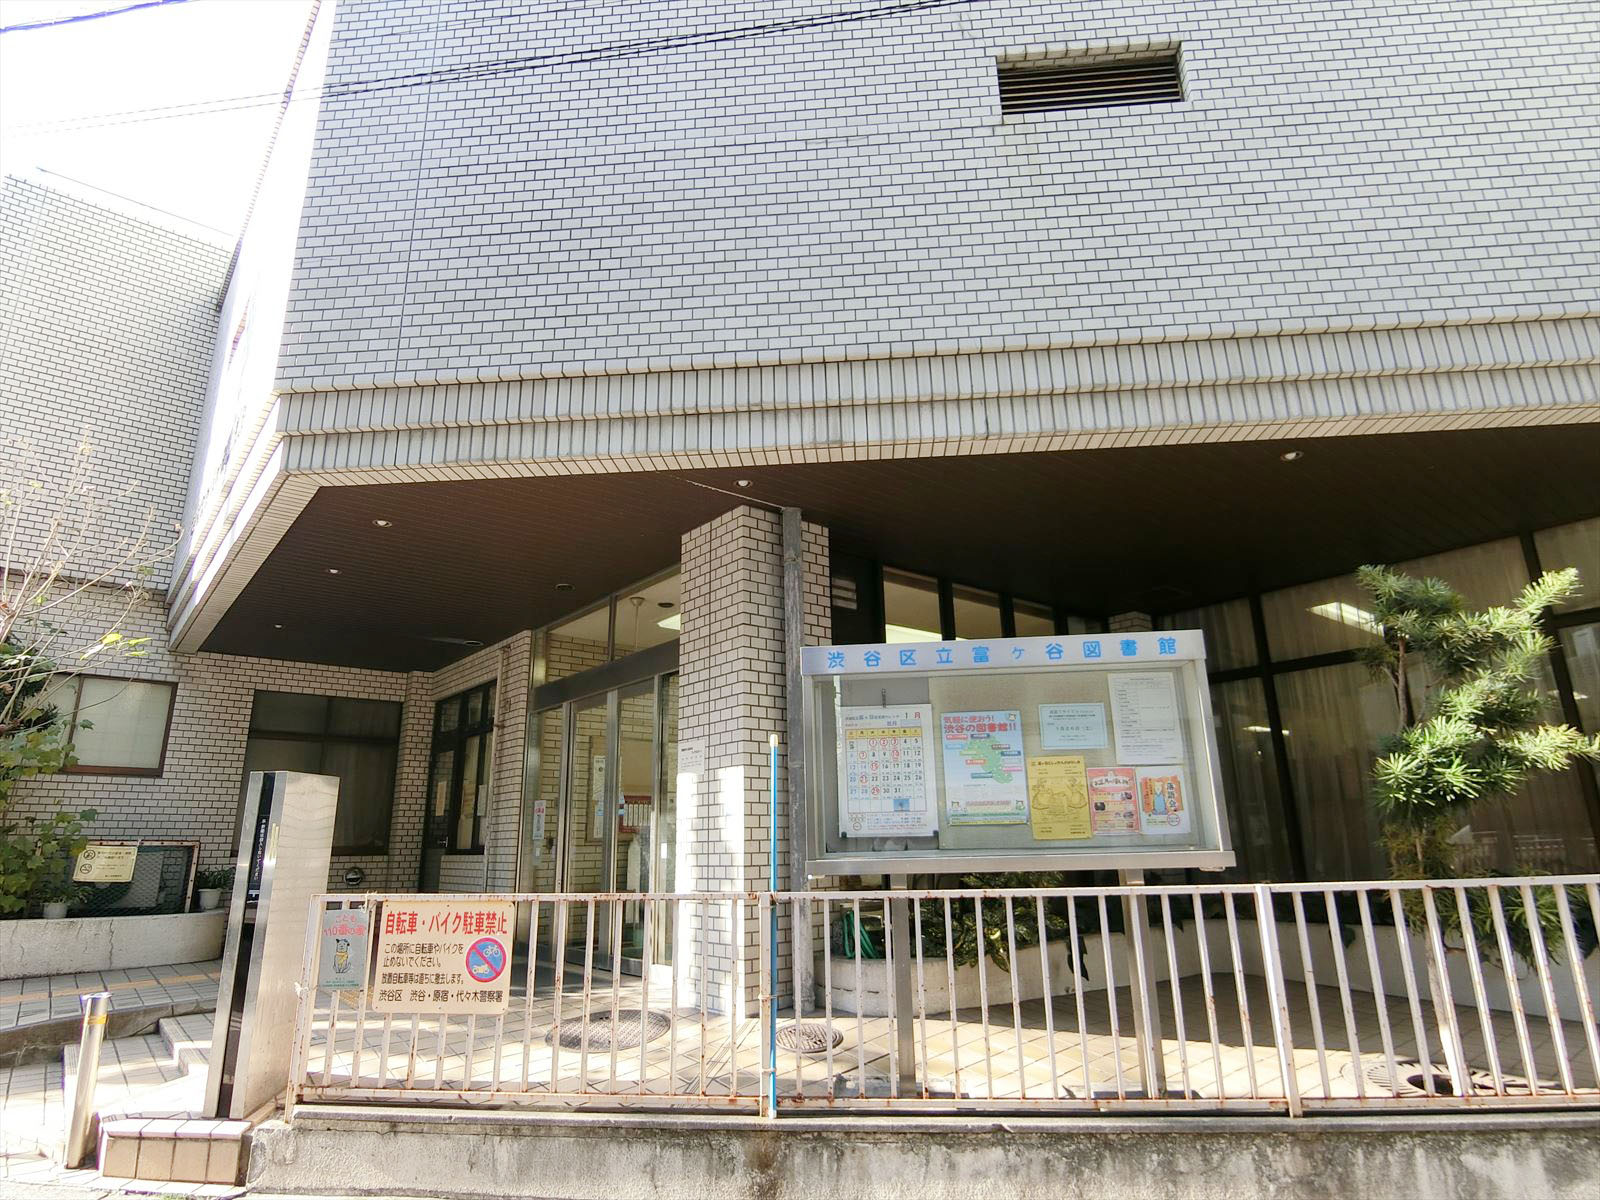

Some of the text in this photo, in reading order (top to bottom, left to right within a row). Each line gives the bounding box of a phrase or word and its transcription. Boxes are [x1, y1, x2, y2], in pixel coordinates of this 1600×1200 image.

[827, 637, 1177, 669] 渋谷区立富ヶ谷図書館
[385, 911, 508, 936] 自転車・バイク駐車禁止
[384, 943, 465, 955] この場所に自転車やバイクを
[383, 956, 442, 968] 止めないでください。
[381, 973, 464, 986] 放置自転車等は直ちに撤去します。
[378, 989, 504, 1003] 渋谷区 渋谷・原宿・代々木警察署
